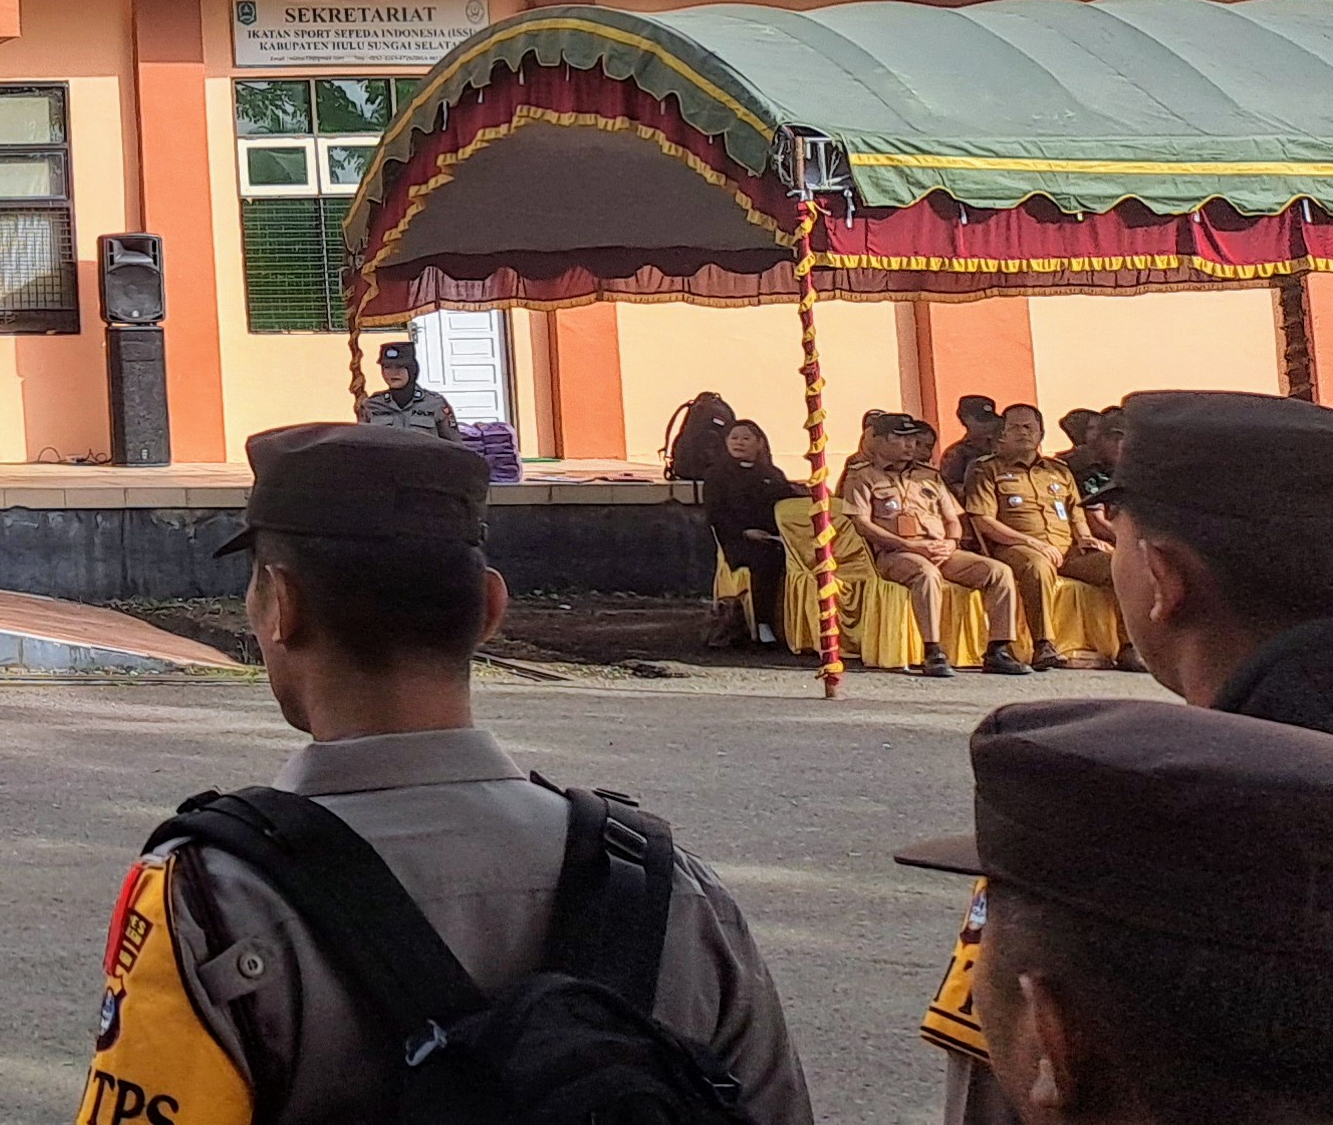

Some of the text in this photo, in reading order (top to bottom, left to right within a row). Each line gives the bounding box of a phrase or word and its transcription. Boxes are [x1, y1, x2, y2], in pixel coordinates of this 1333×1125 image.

[284, 6, 437, 24] SEKRETARIAT
[247, 28, 292, 39] IKATAN
[294, 28, 332, 39] SPORT
[334, 28, 380, 39] SEPEDA
[381, 28, 447, 39] INDONESIA
[259, 41, 330, 51] KABUPATEN
[332, 41, 365, 51] HULU
[367, 41, 413, 51] SUNGAI
